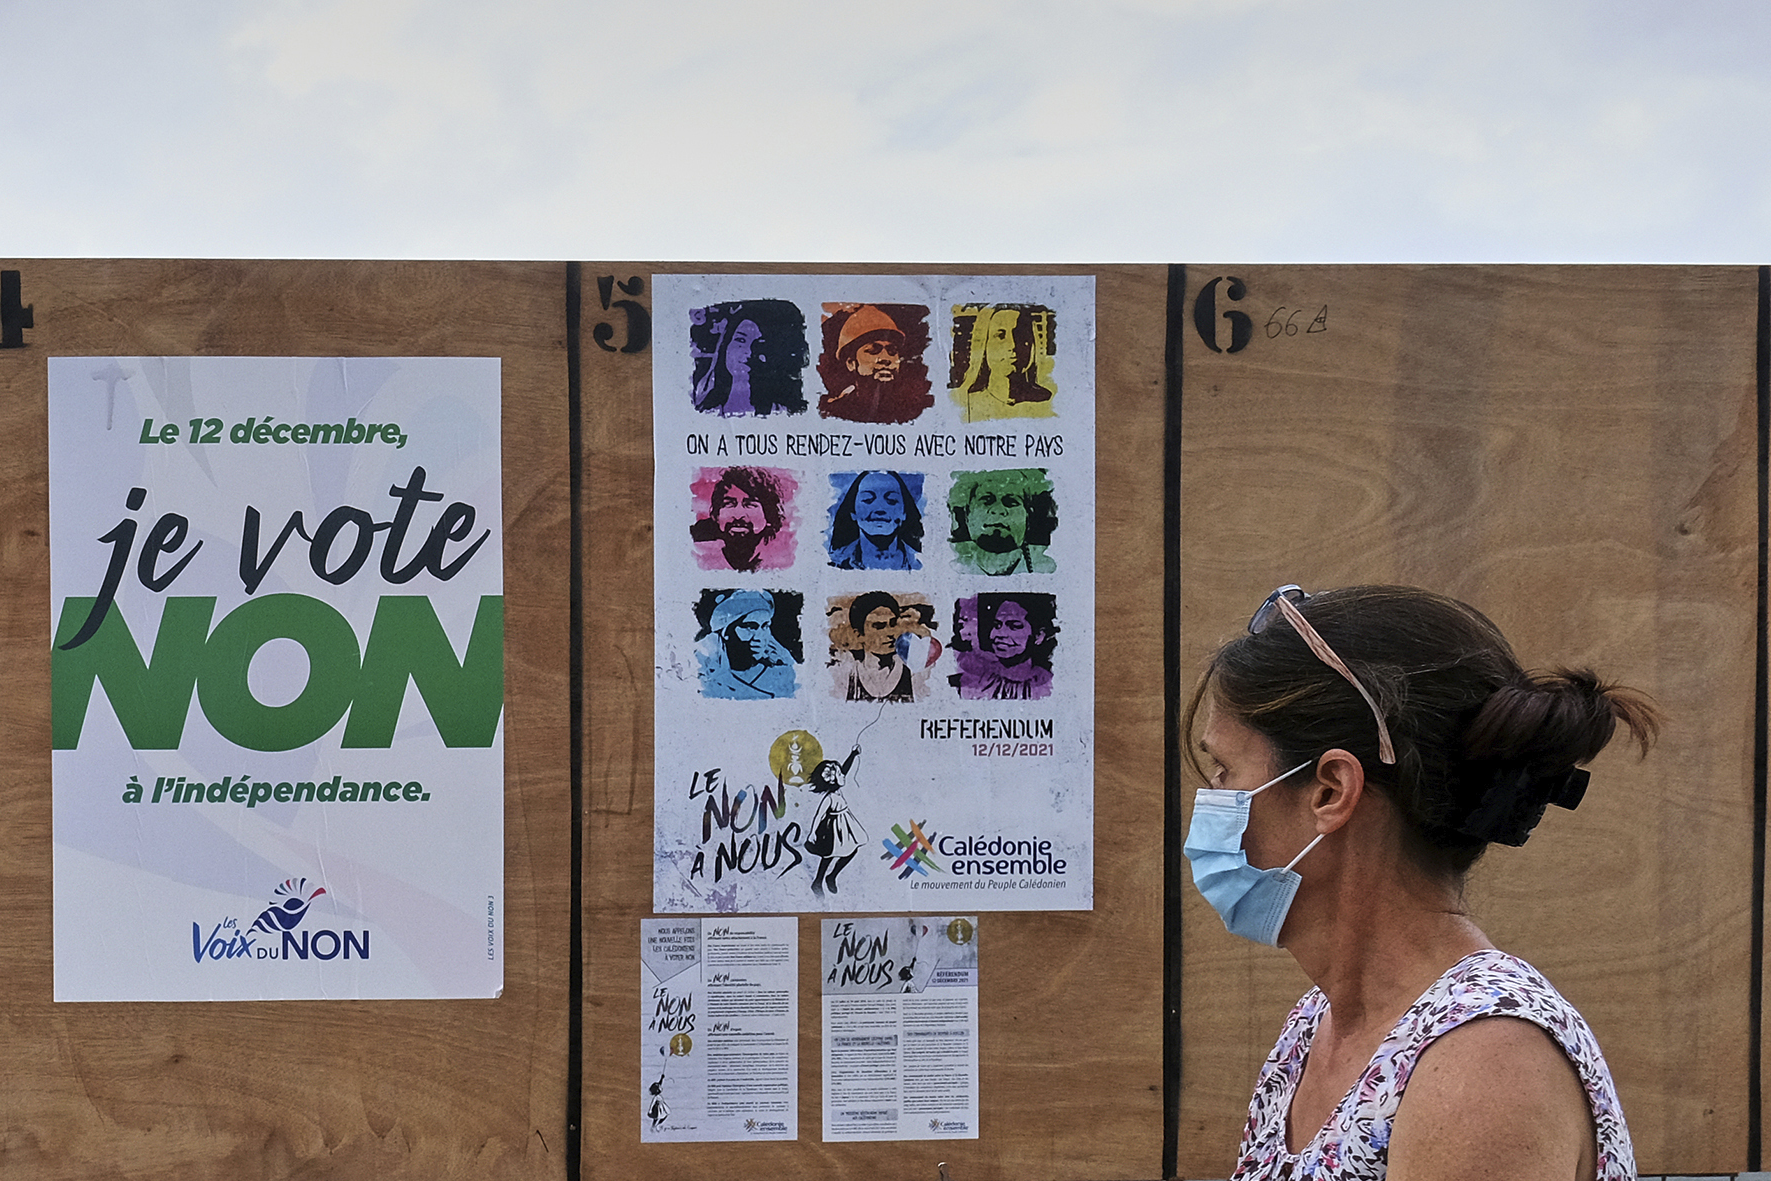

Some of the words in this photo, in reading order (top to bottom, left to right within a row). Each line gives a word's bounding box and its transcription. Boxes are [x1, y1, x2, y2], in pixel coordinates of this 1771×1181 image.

[592, 276, 651, 354] 5
[1193, 276, 1253, 354] 6
[139, 418, 180, 445] Le
[188, 418, 224, 445] 12
[229, 416, 408, 450] décembre,
[686, 434, 709, 456] ON
[716, 434, 728, 456] A
[735, 434, 778, 456] TOUS
[786, 434, 907, 457] RENDEZ-VOUS
[914, 434, 956, 457] AVEC
[964, 434, 1017, 458] NOTRE
[1025, 435, 1064, 458] PAYS
[57, 487, 204, 651] je
[238, 465, 491, 596] vote
[51, 592, 504, 753] NON
[920, 718, 1054, 739] REFERENDUM
[972, 743, 1054, 758] 12/12/2021
[122, 775, 143, 804] à
[689, 768, 721, 800] LE
[702, 767, 786, 845] NON
[690, 844, 705, 880] À
[715, 822, 803, 883] NOUS
[938, 835, 1052, 857] Calédonie
[951, 852, 1067, 875] ensemble
[910, 880, 919, 890] Le
[921, 881, 973, 890] mouvement
[975, 879, 986, 890] du
[988, 879, 1017, 892] Peuple
[1019, 878, 1067, 890] Calédonien
[488, 917, 494, 928] DU
[833, 923, 854, 938] LE
[192, 921, 257, 964] Voix
[257, 947, 278, 960] DU
[282, 929, 370, 961] NON
[837, 928, 889, 964] NON
[840, 959, 894, 991] NOUS
[653, 988, 668, 999] LE
[656, 992, 692, 1017] NON
[658, 1014, 696, 1034] NOUS
